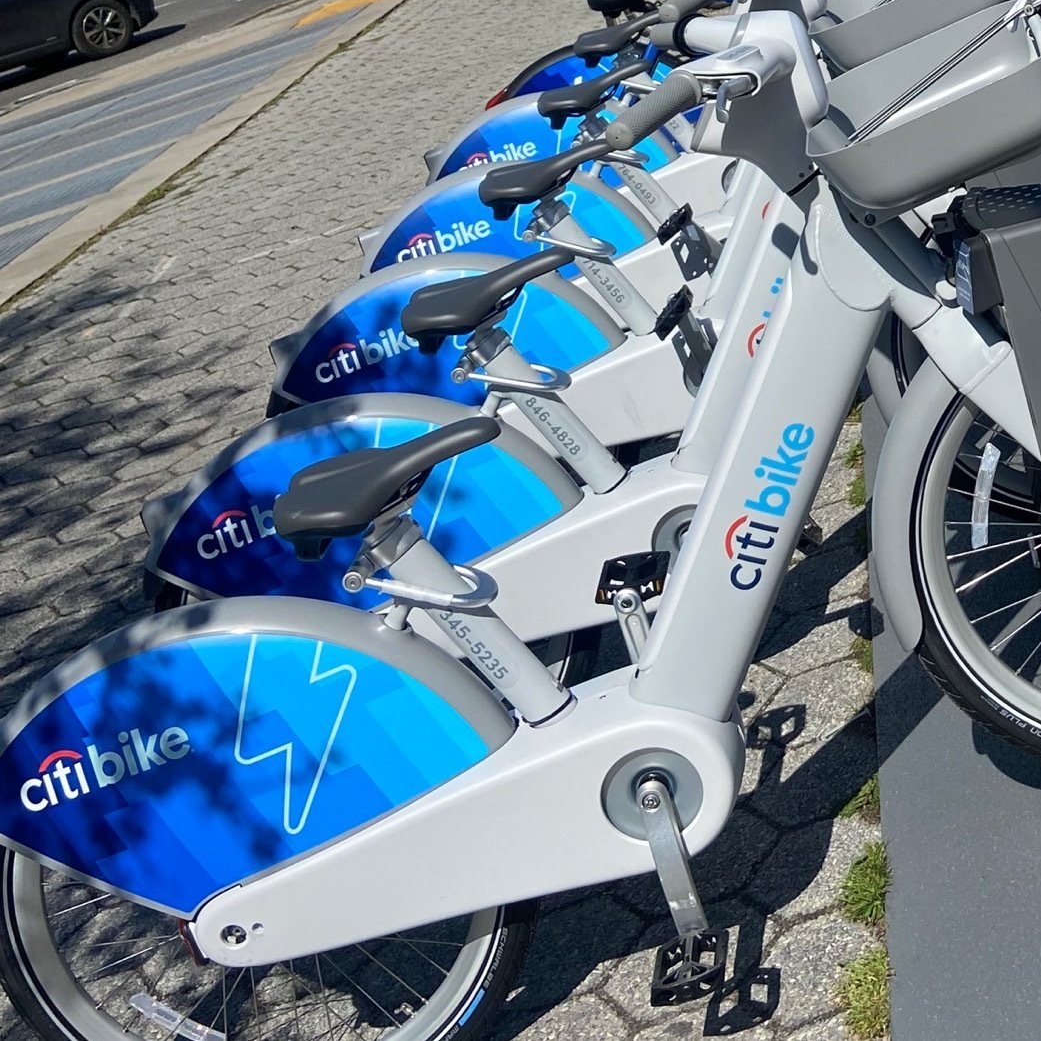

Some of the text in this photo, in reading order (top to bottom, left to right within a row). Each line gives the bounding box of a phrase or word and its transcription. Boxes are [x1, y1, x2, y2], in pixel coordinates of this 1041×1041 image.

[397, 218, 491, 262] citi bike
[315, 343, 361, 384] citi
[525, 396, 581, 456] 846-4828
[744, 423, 816, 517] bike
[196, 509, 251, 560] citi
[724, 515, 780, 591] citi
[438, 609, 509, 681] 345-5235
[999, 709, 1027, 729] PLUS
[19, 725, 190, 813] citi bike
[483, 927, 508, 989] SCHWALBE
